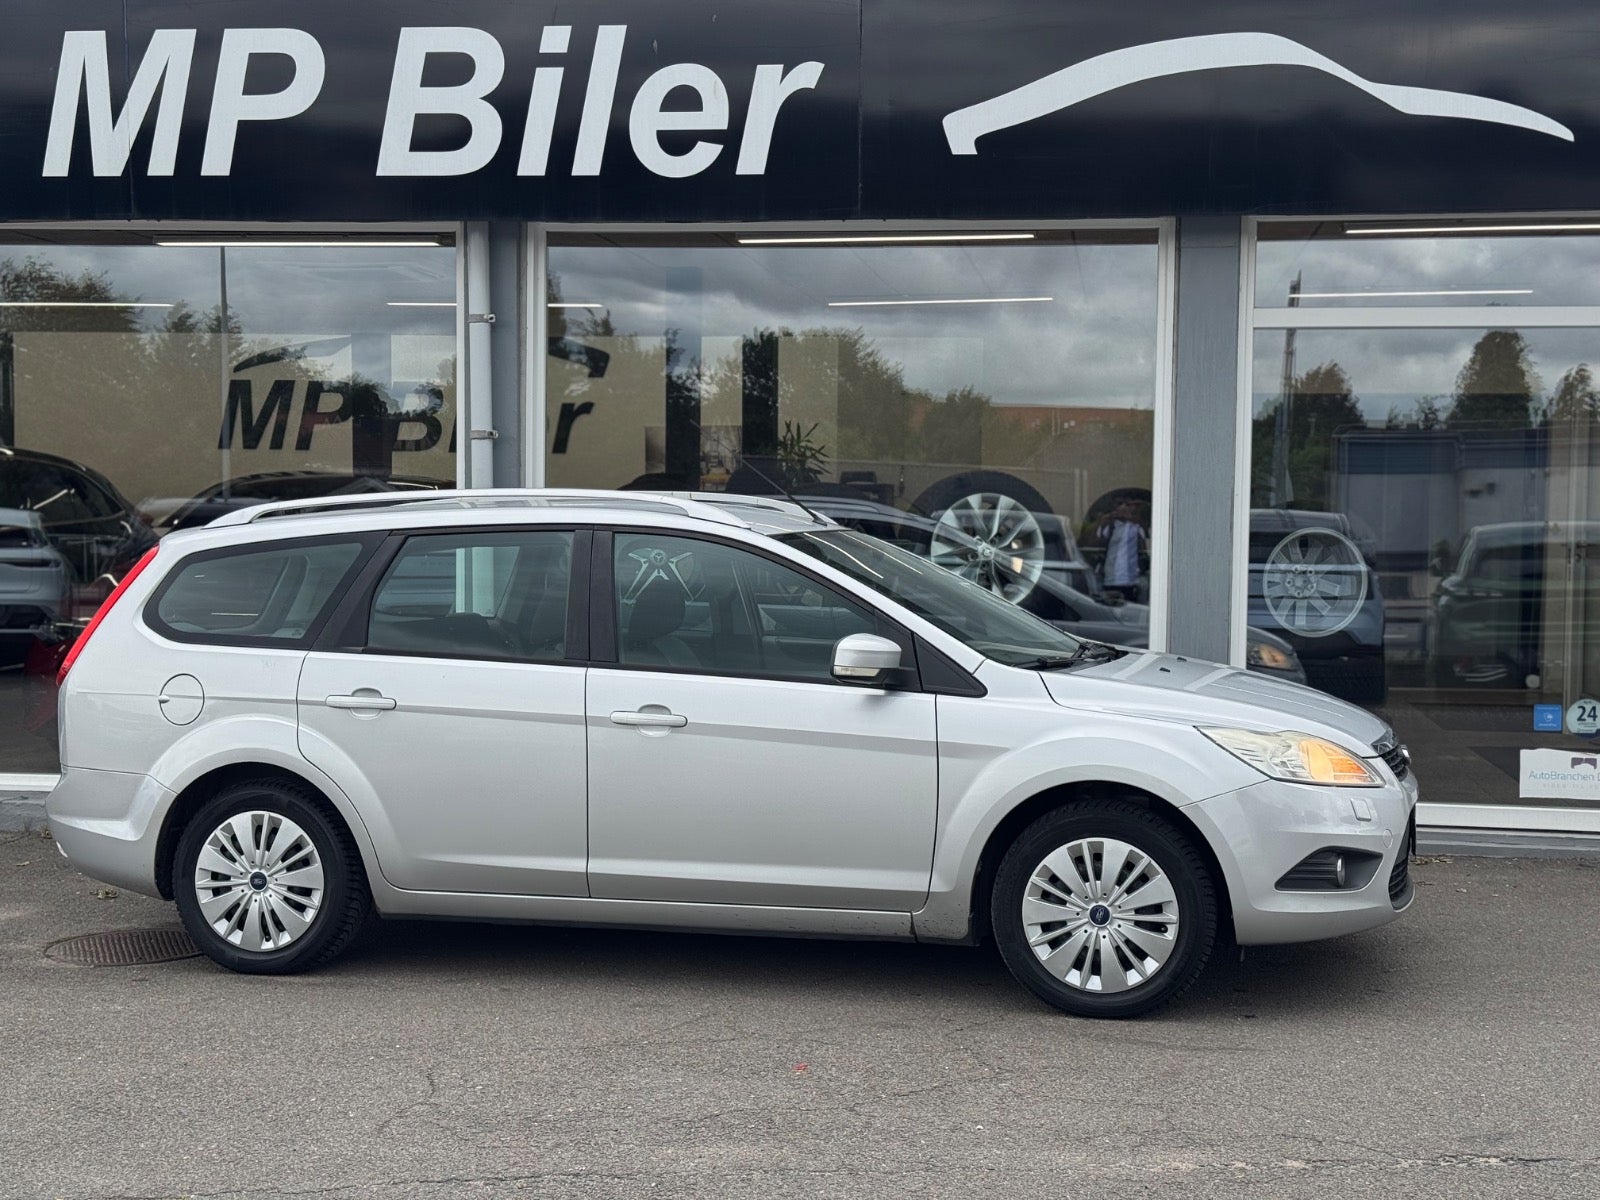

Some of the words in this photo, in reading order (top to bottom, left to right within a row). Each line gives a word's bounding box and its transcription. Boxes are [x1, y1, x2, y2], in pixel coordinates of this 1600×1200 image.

[41, 28, 326, 178] MP
[375, 24, 825, 179] Biler
[217, 379, 354, 451] MP
[1577, 705, 1598, 722] 24
[1528, 770, 1595, 782] AutoBranchen
